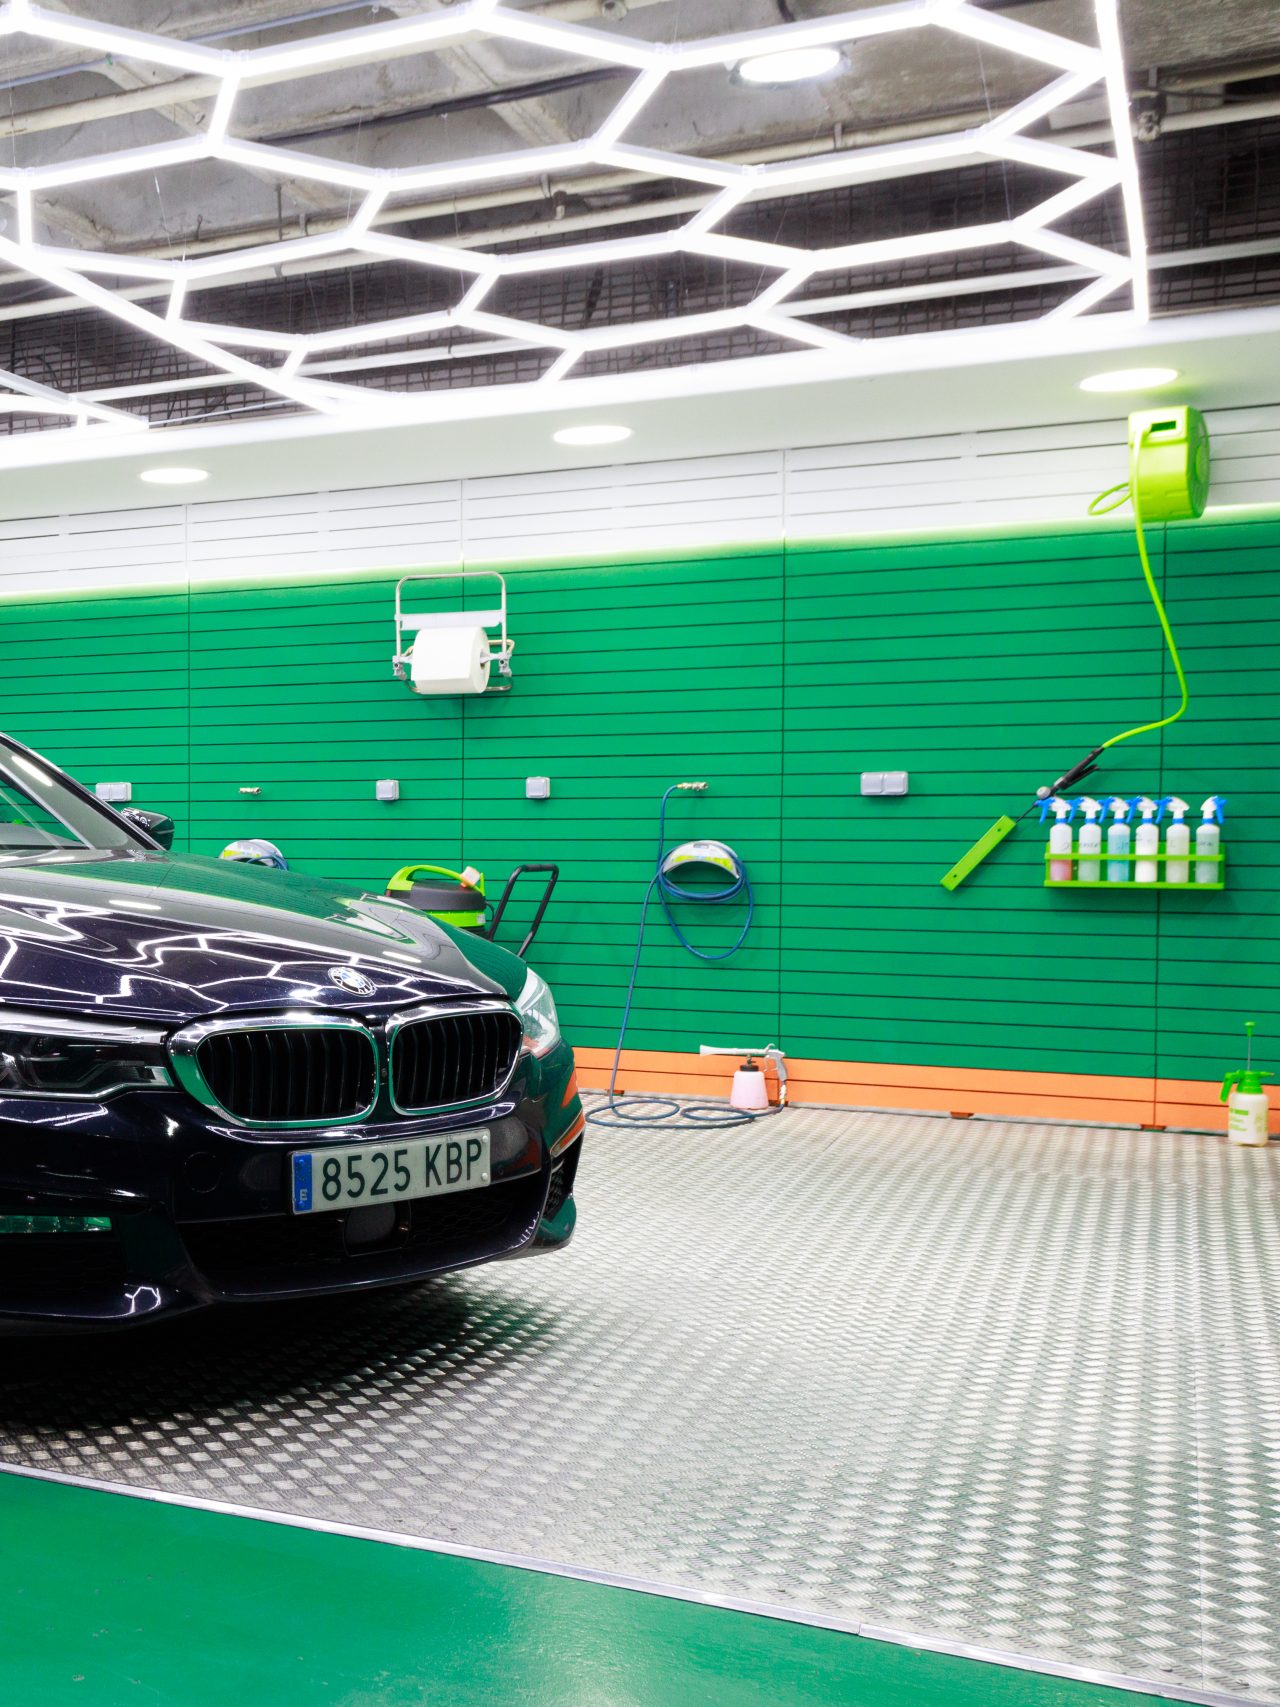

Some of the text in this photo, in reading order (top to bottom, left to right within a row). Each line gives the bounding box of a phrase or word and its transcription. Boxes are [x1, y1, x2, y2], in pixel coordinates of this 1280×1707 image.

[321, 1138, 482, 1202] 8525 KBP
[299, 1188, 308, 1201] E
